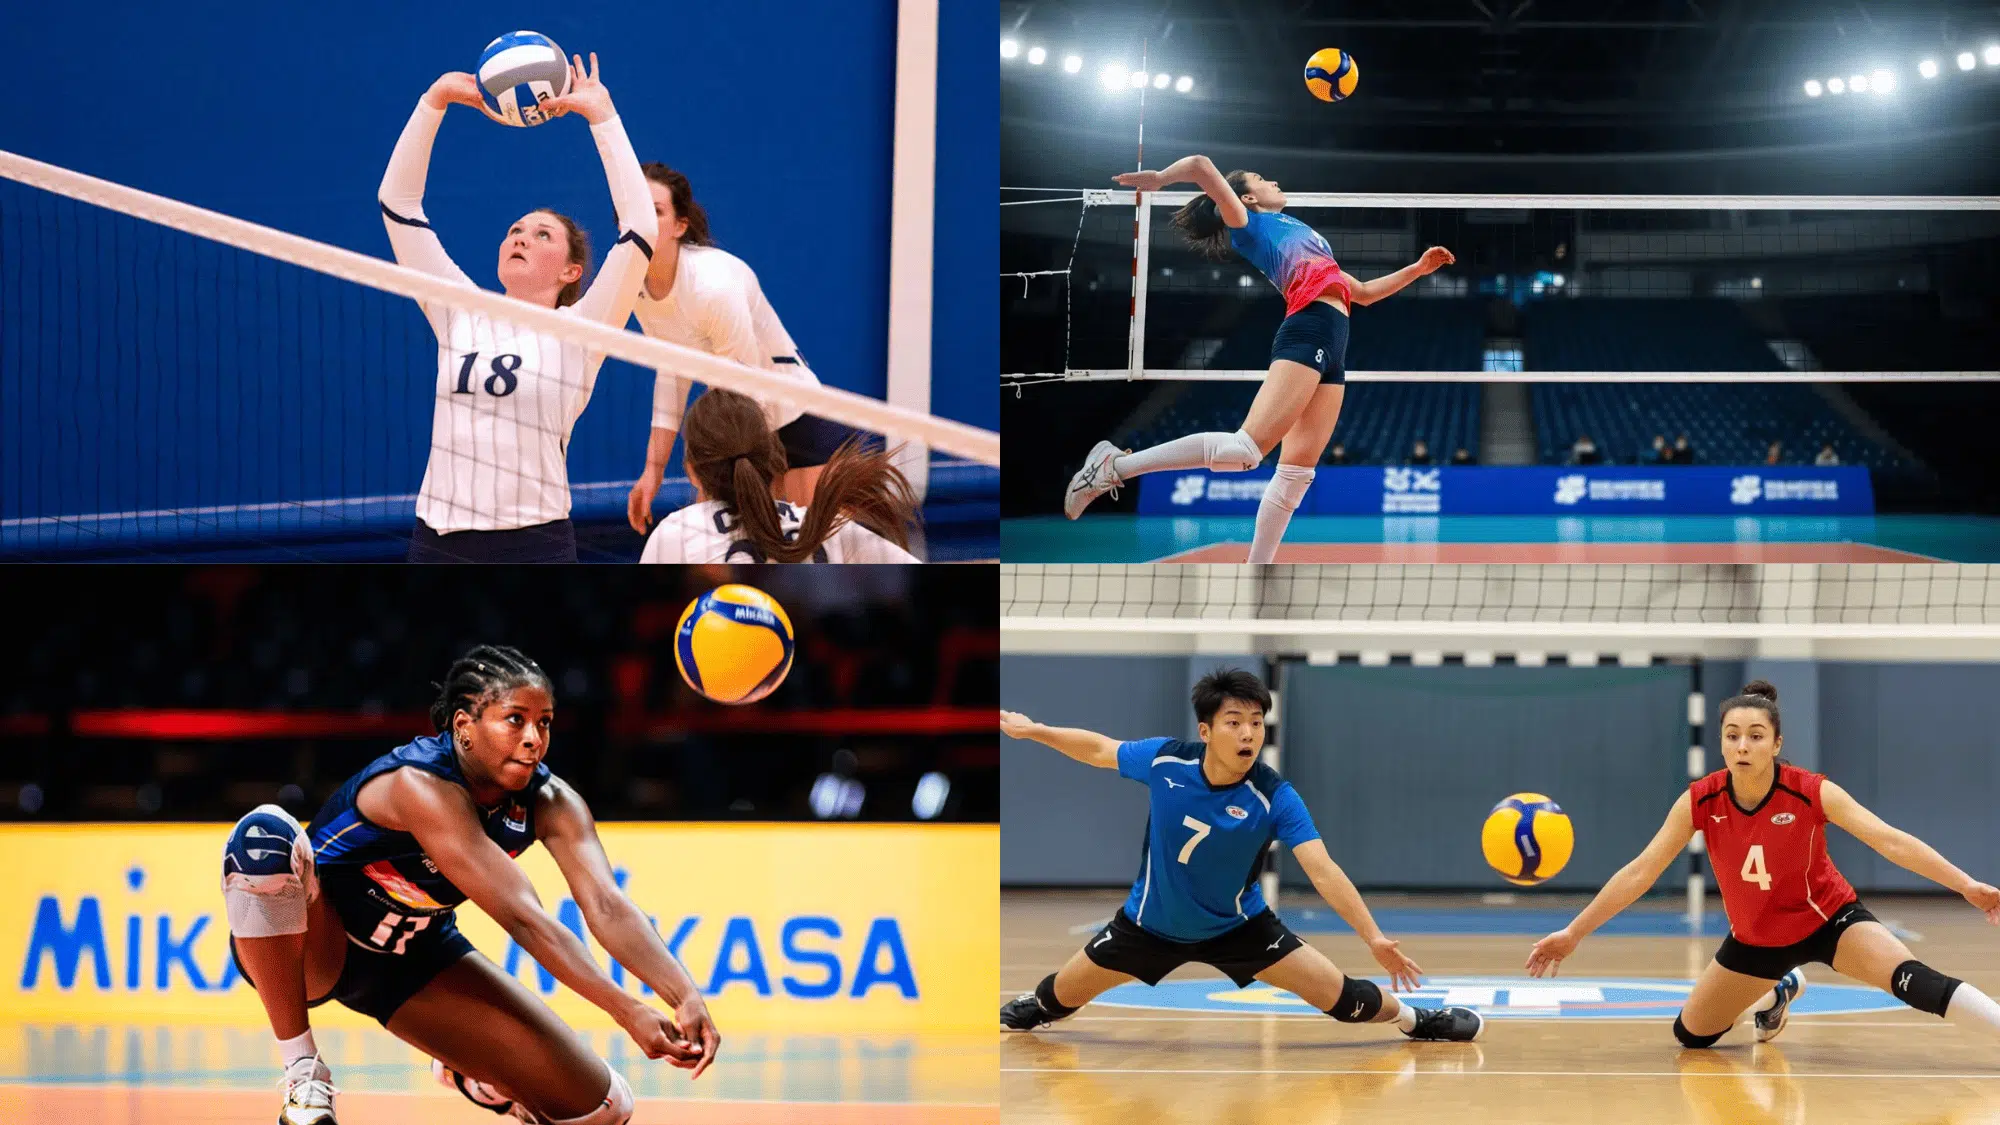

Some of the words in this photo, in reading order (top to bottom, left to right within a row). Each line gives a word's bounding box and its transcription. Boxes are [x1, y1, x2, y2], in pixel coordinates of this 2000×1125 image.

[452, 351, 522, 397] 18
[1315, 348, 1324, 363] 8
[1177, 815, 1211, 865] 7
[1741, 845, 1771, 890] 4
[369, 911, 431, 955] 17
[1093, 930, 1112, 948] 7
